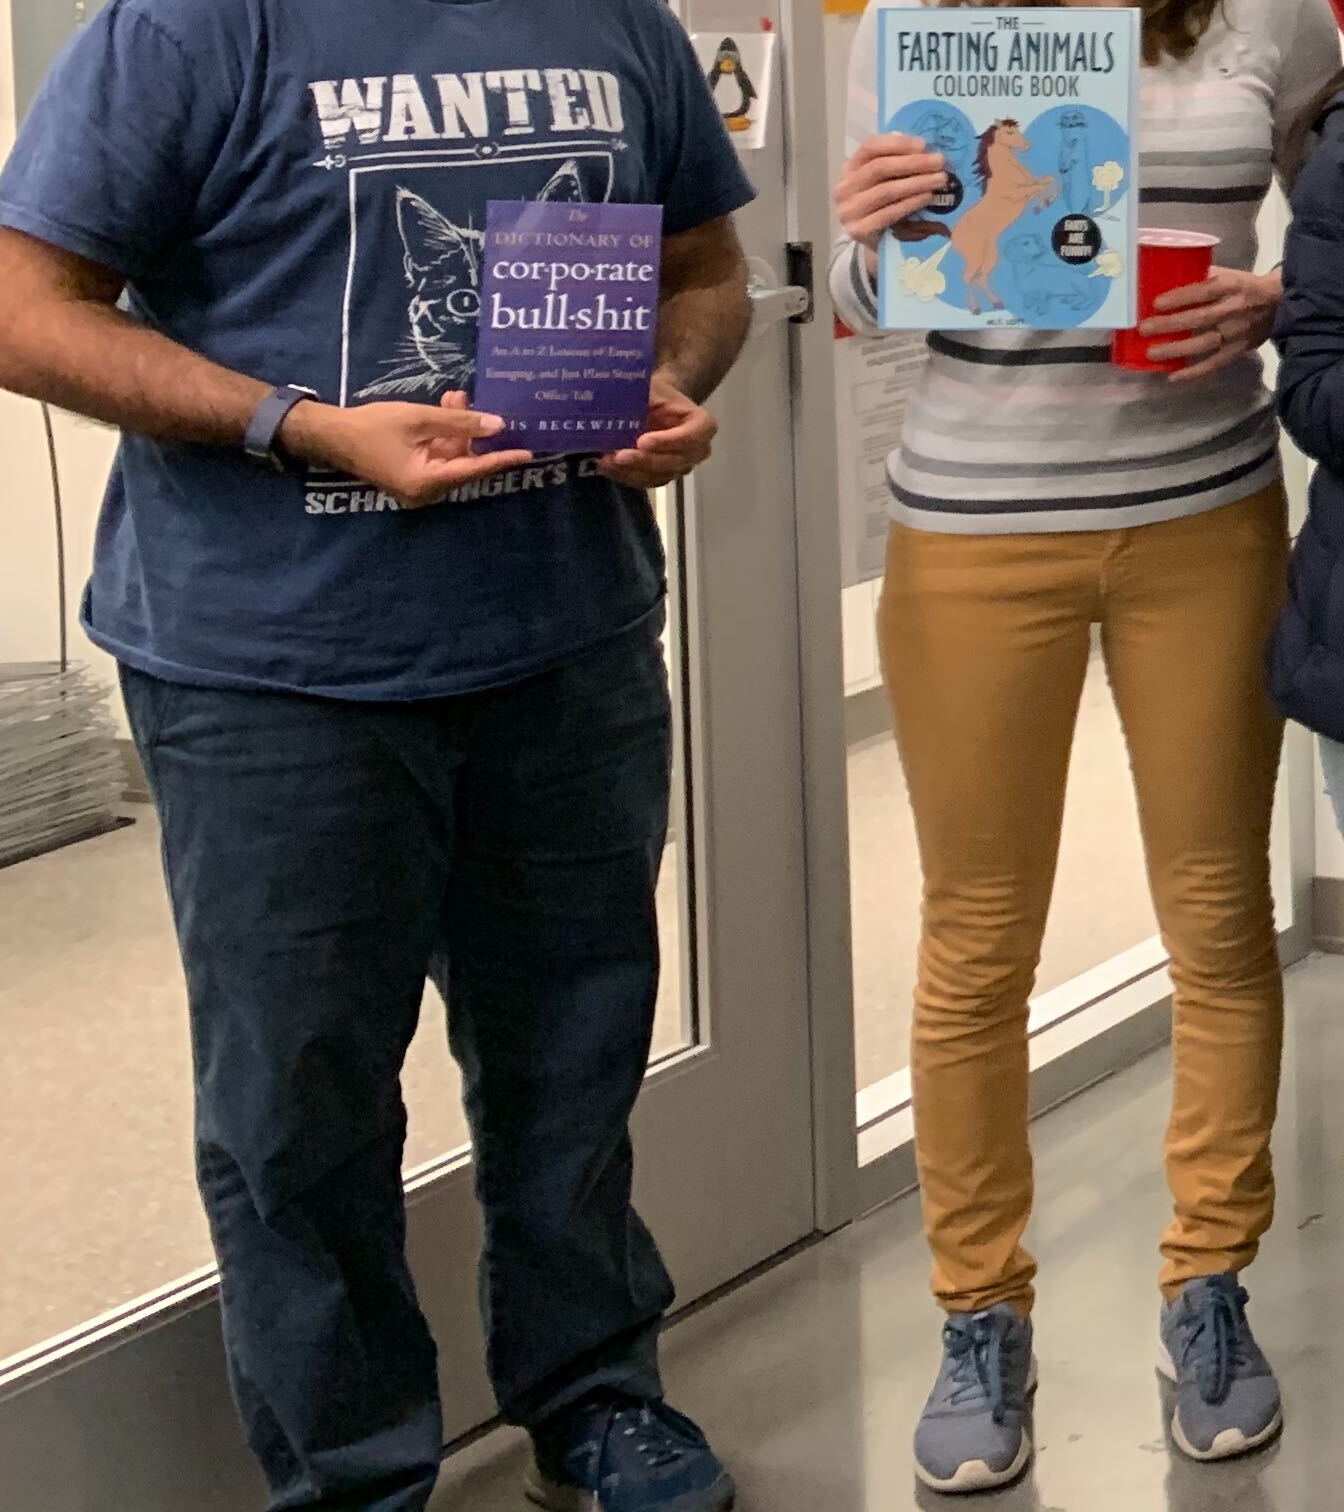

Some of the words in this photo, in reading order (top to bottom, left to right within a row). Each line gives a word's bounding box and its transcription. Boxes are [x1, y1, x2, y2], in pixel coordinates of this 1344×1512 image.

[996, 17, 1019, 30] THE
[898, 32, 999, 73] FARTING
[1007, 31, 1115, 74] ANIMALS
[933, 75, 1023, 97] COLORING
[1031, 75, 1080, 97] BOOK
[308, 69, 624, 149] WANTED
[495, 232, 619, 248] DICTIONARY
[538, 419, 641, 431] BECKWITH
